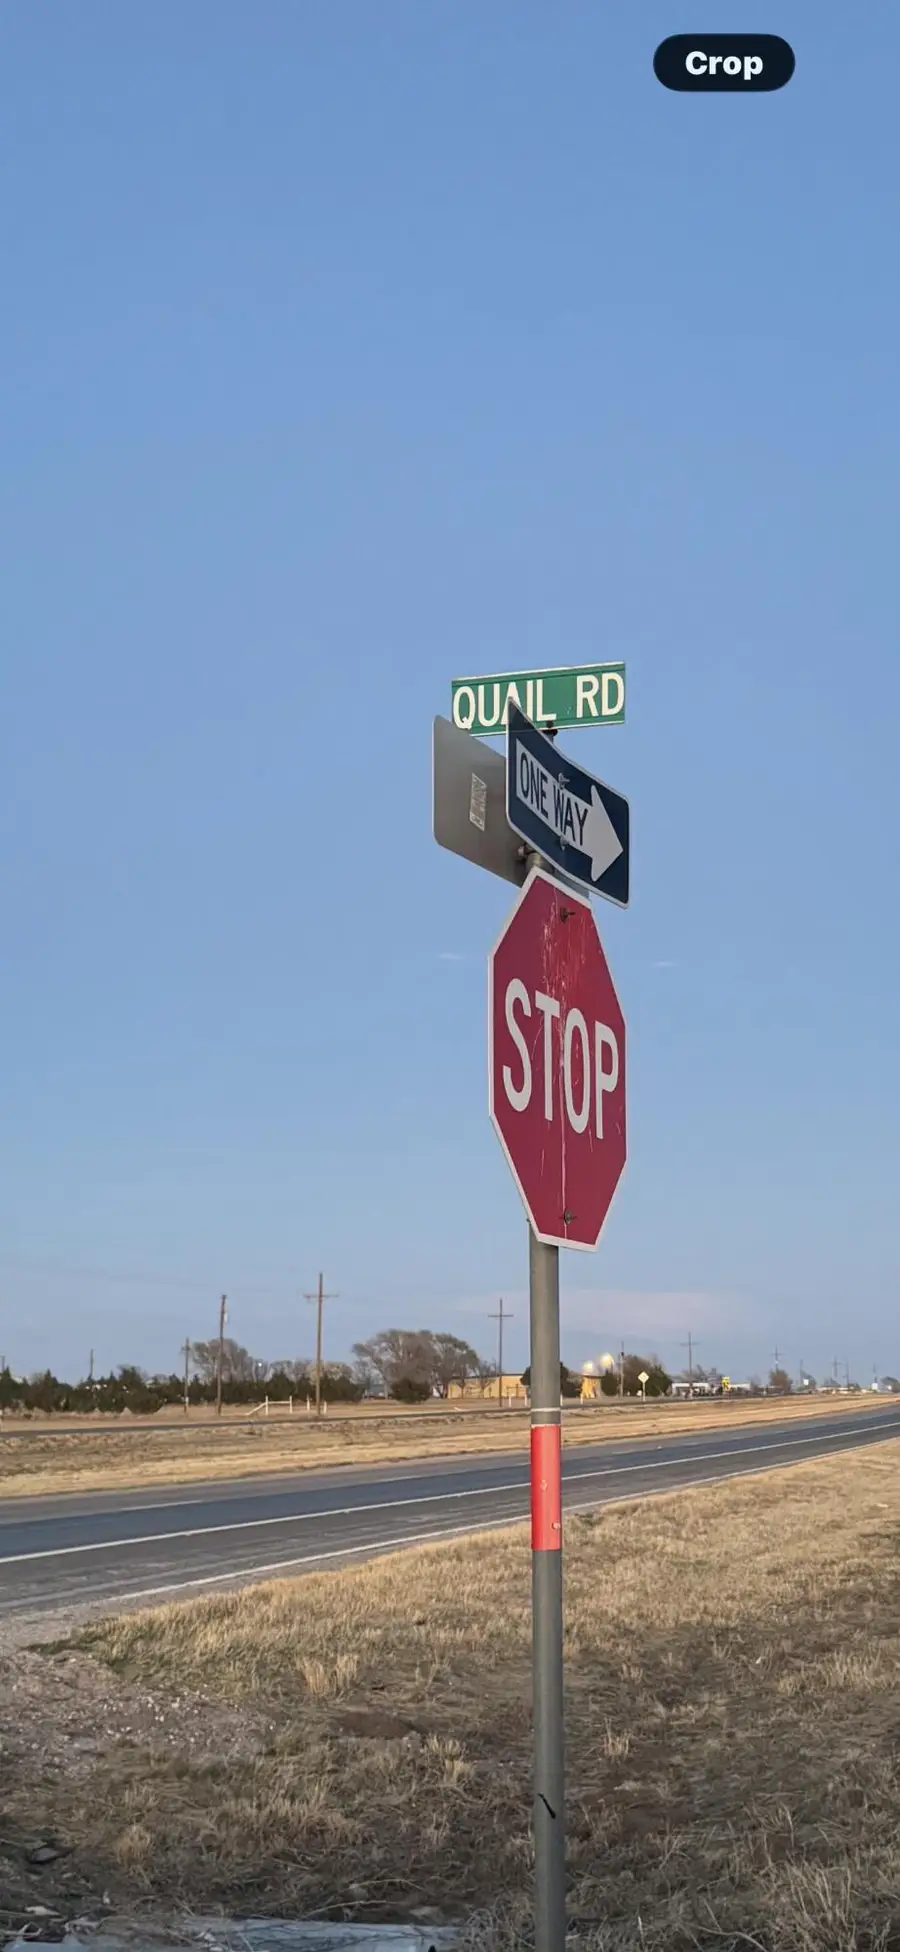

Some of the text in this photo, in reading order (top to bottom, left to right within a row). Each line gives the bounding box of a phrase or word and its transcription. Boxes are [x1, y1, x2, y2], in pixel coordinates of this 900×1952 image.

[453, 672, 625, 729] QUAIL RD
[520, 752, 549, 822] ONE
[553, 785, 588, 846] WAY
[503, 978, 619, 1139] STOP
